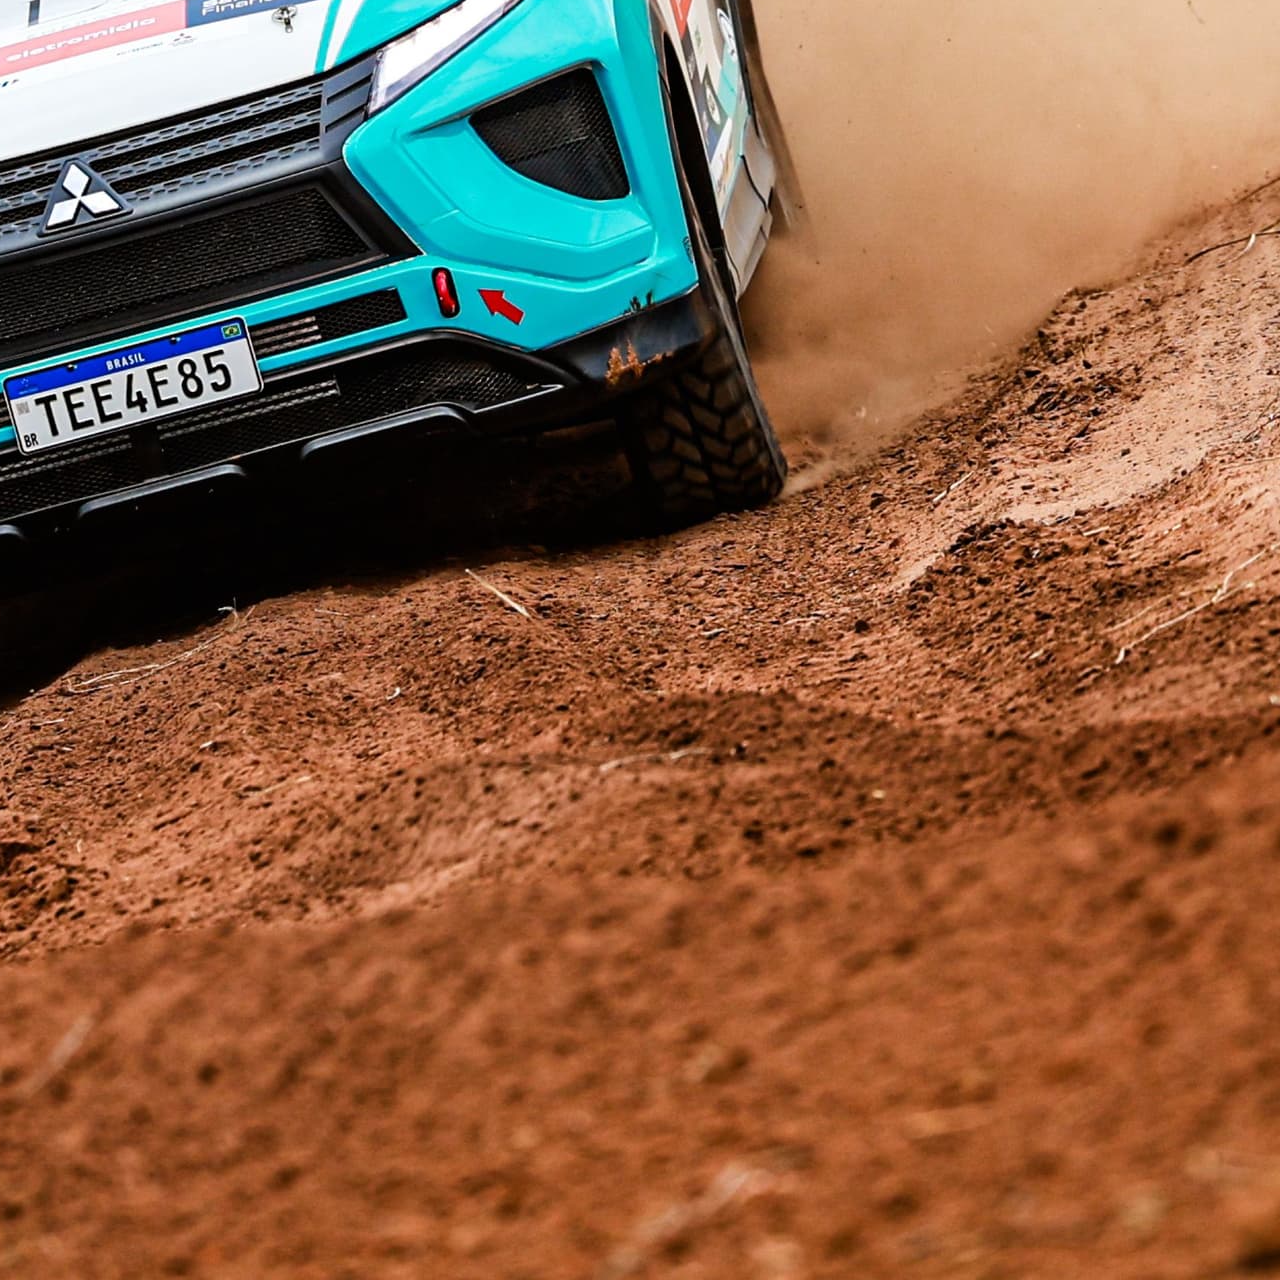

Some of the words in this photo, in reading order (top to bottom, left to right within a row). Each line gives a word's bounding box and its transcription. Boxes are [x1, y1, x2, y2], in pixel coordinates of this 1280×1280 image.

[6, 16, 158, 62] eletromidia
[105, 352, 146, 371] BRASIL
[35, 349, 232, 438] TEE4E85
[24, 433, 39, 448] BR
